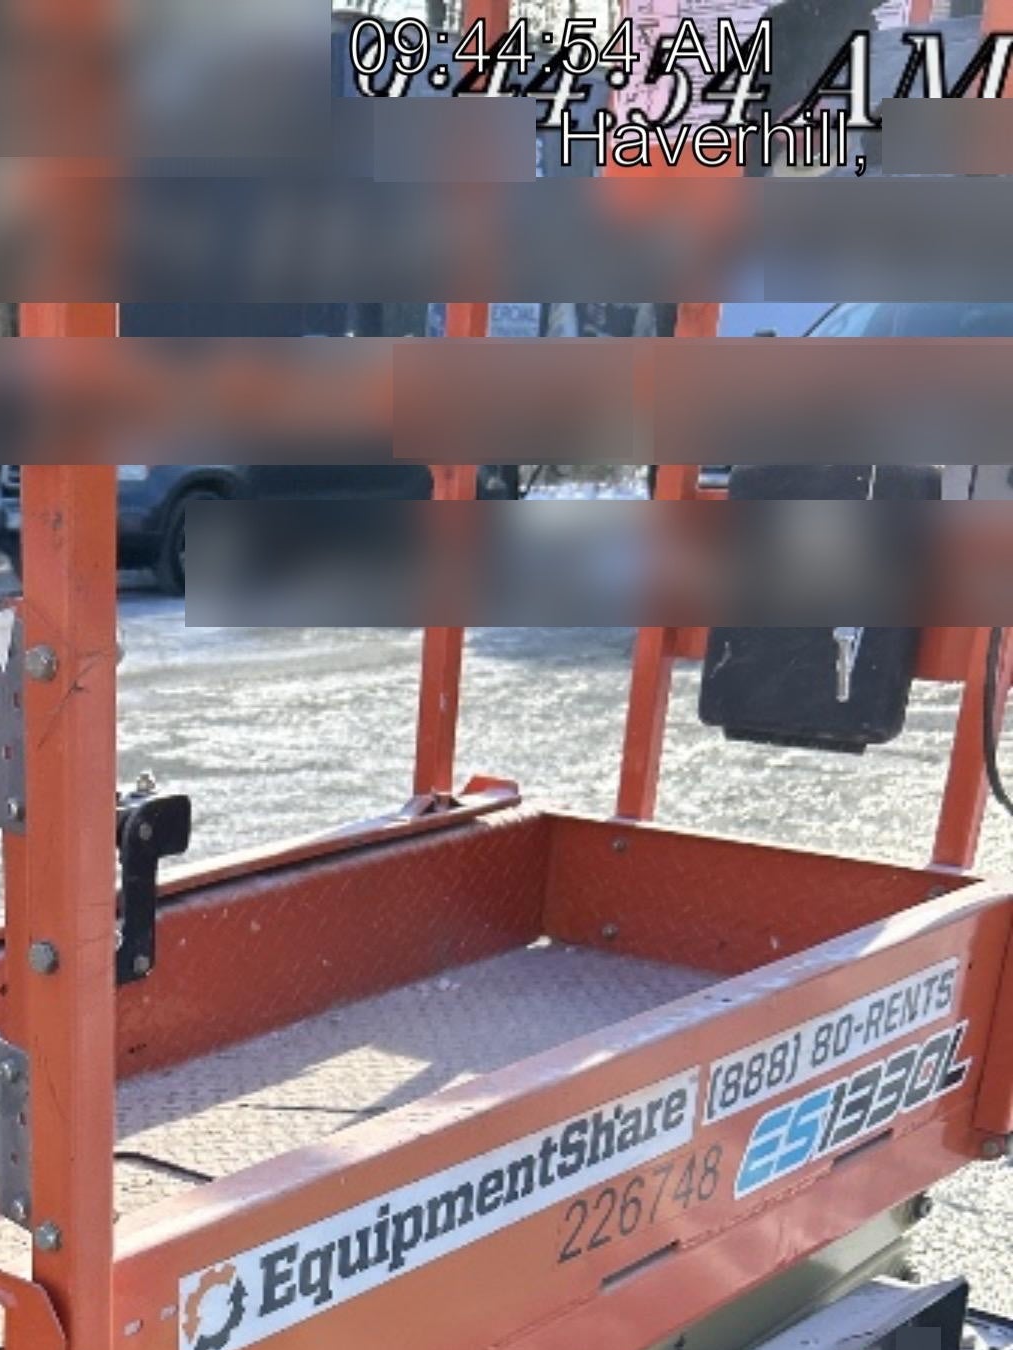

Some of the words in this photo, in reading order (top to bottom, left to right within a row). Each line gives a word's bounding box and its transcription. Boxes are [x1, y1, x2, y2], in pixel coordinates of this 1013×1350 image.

[706, 1031, 802, 1121] (888)
[810, 967, 956, 1068] 80-RENTS
[734, 1018, 974, 1200] ES1330L
[257, 1085, 688, 1318] EquipmentShare
[555, 1144, 724, 1264] 226748
